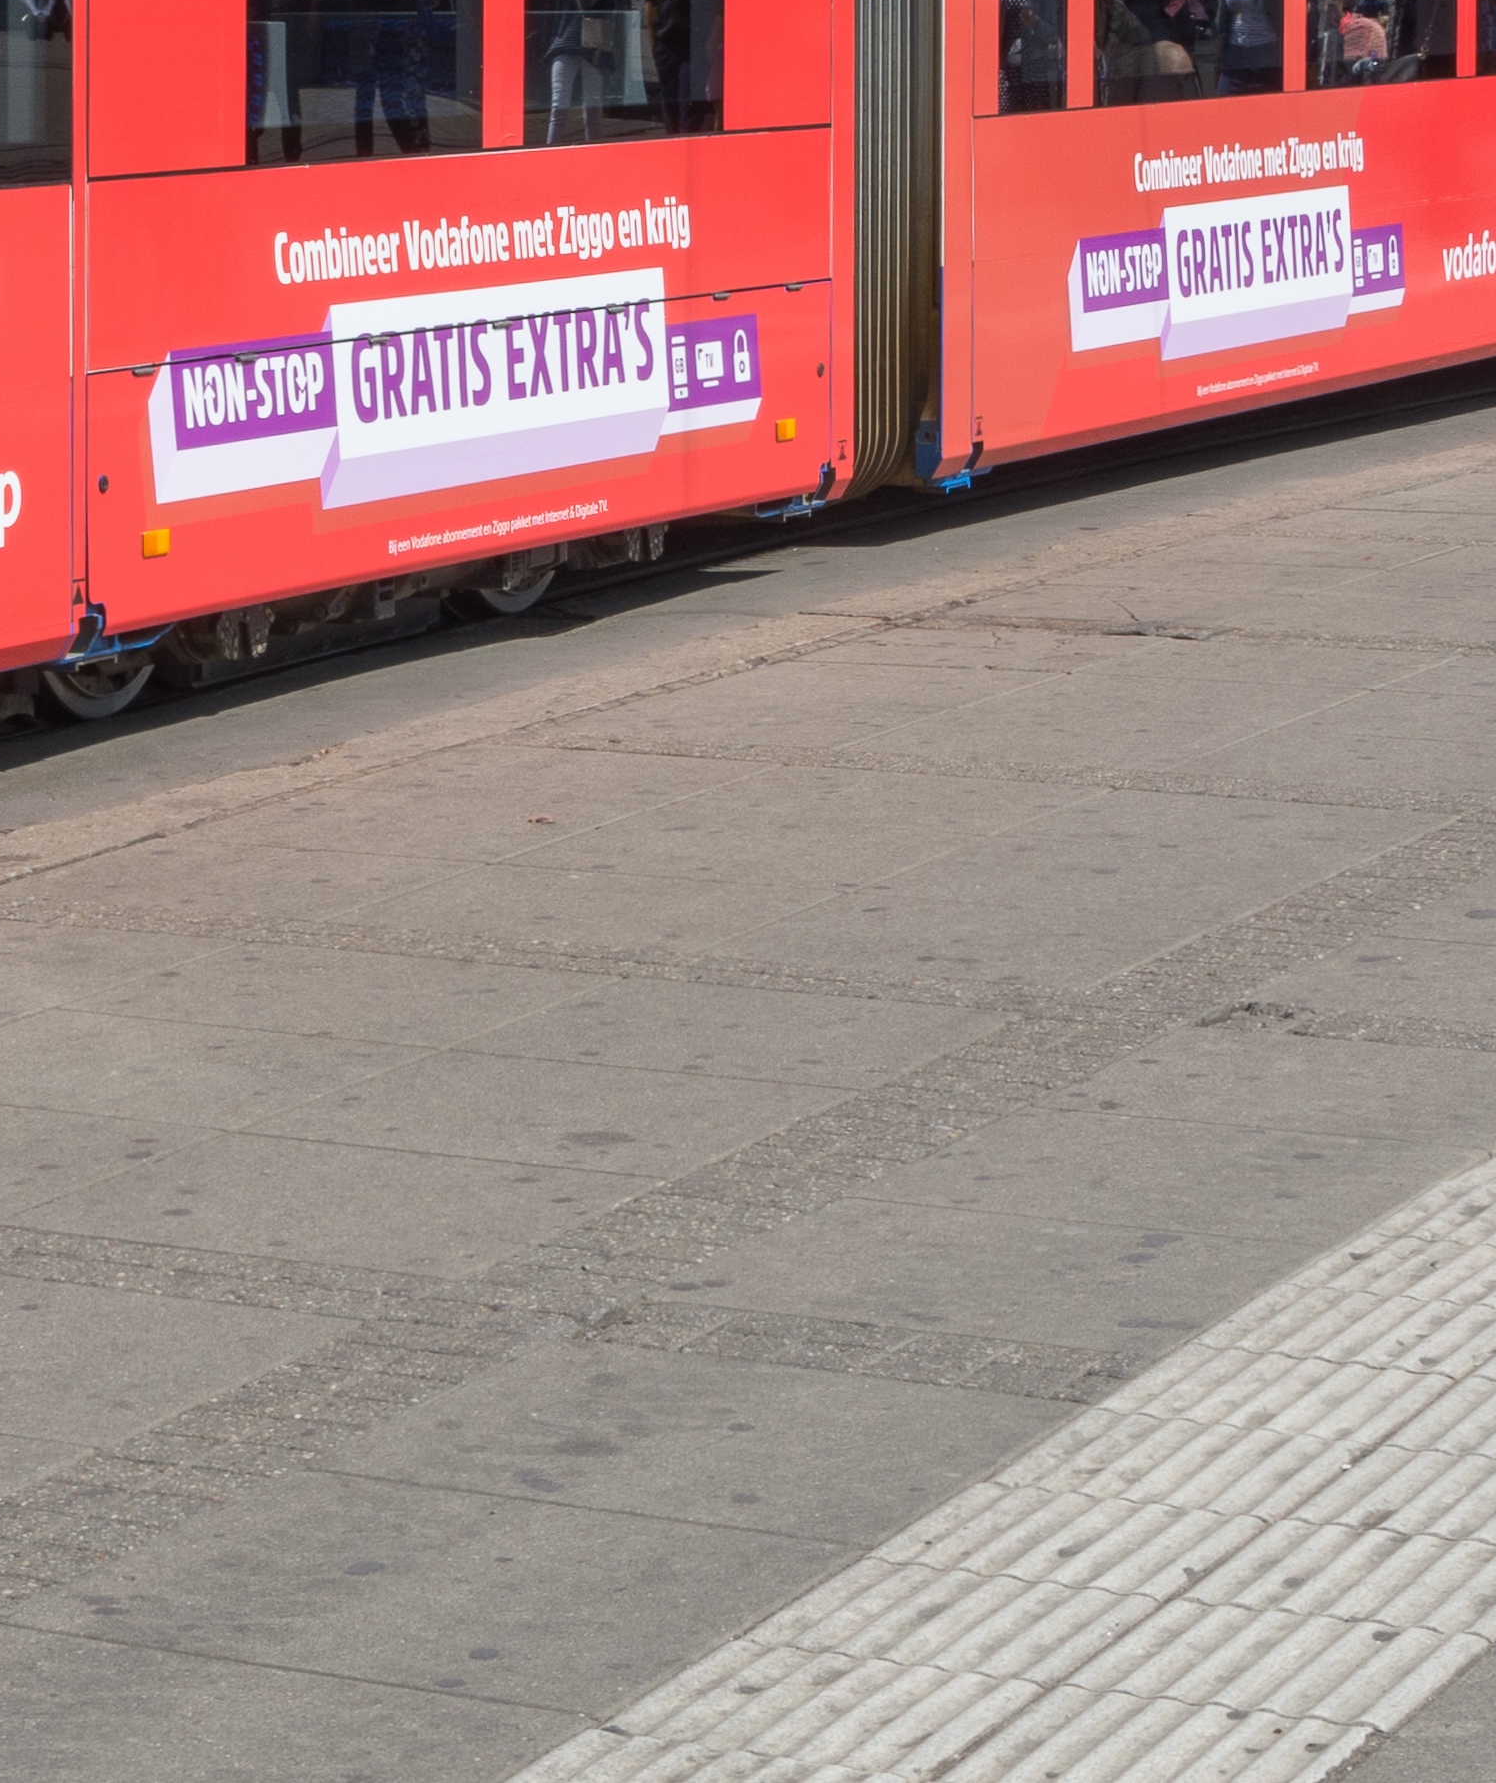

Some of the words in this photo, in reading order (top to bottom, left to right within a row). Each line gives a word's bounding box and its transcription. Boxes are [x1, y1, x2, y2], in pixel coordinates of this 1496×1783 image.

[1134, 148, 1203, 192] Combineer
[1203, 143, 1263, 183] Vodafone
[1264, 140, 1287, 176] met
[1288, 137, 1320, 178] Ziggo
[1322, 140, 1336, 170] en
[1337, 131, 1364, 172] krijg
[274, 227, 401, 285] Combineer
[403, 215, 510, 271] Vodafone
[512, 211, 553, 259] met
[557, 205, 614, 260] Ziggo
[618, 207, 643, 249] en
[644, 195, 690, 250] krijg
[1085, 243, 1162, 298] NON-STOP
[1176, 220, 1254, 298] GRATIS
[1260, 208, 1344, 284] EXTRA'S
[182, 351, 324, 430] NON-STOP
[351, 318, 492, 424] GRATIS
[507, 298, 655, 401] EXTRA'S
[388, 539, 398, 556] Bij
[398, 538, 410, 551] een
[411, 533, 442, 550] Vodafone
[442, 524, 483, 545] abonnement
[483, 524, 492, 536] en
[492, 520, 510, 537] Ziggo
[511, 513, 532, 533] pakket
[532, 512, 545, 526] met
[569, 505, 575, 518] &
[575, 501, 598, 520] Digitale
